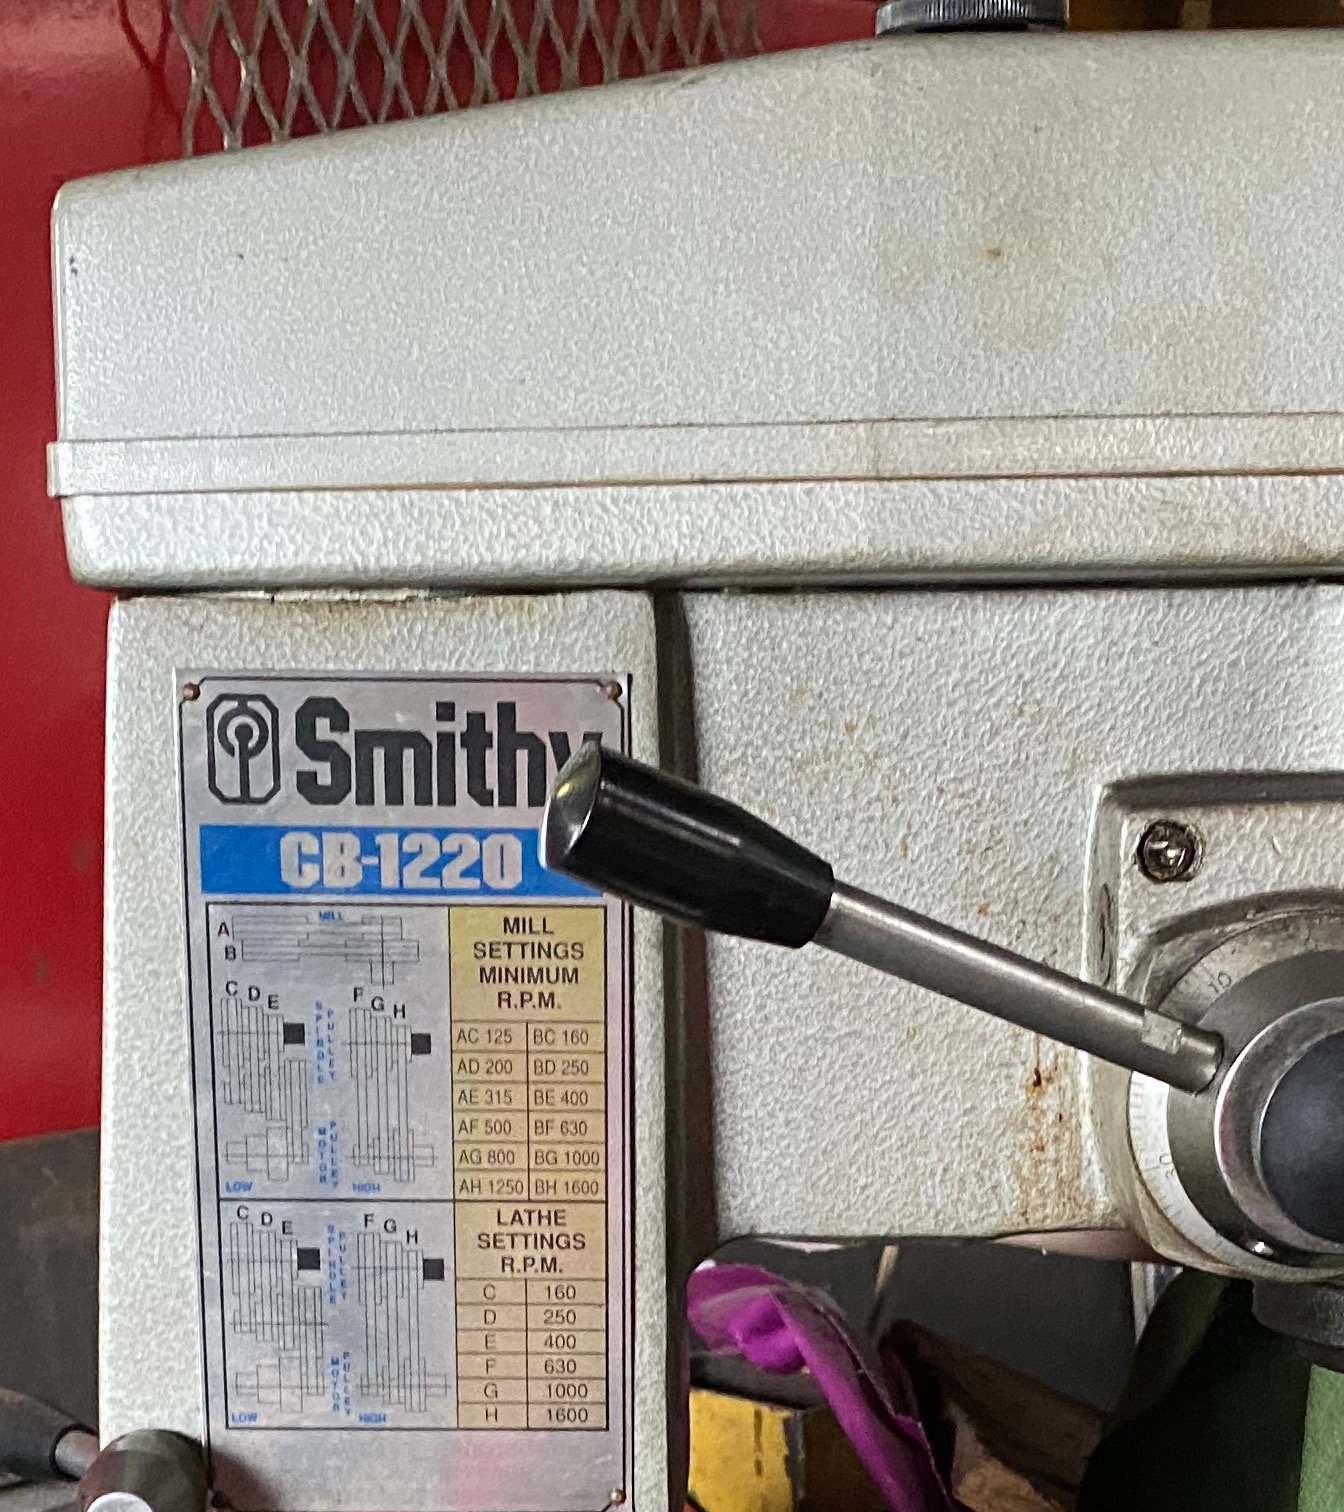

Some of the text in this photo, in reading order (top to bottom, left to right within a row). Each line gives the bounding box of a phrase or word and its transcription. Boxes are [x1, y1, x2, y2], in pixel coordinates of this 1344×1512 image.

[280, 831, 523, 890] CB-1220
[217, 922, 230, 937] A
[503, 916, 555, 935] MILL
[224, 944, 237, 961] B
[473, 941, 585, 960] SETTINGS
[479, 966, 579, 985] MINIMUM
[225, 980, 280, 1010] C D E
[353, 986, 406, 1019] F G H
[497, 990, 563, 1011] R.P.M.
[457, 1028, 513, 1045] AC 125
[533, 1028, 589, 1046] BC 160
[457, 1058, 513, 1075] AD 200
[533, 1059, 589, 1076] BD 250
[457, 1089, 513, 1106] AE 315
[534, 1089, 589, 1106] BE 400
[457, 1119, 512, 1136] AF 500
[534, 1120, 588, 1137] BF 630
[458, 1149, 515, 1166] AG 800
[534, 1150, 600, 1167] BG 1000
[225, 1181, 253, 1192] LOW
[459, 1179, 524, 1196] AH 1250
[535, 1180, 599, 1197] BH 1600
[236, 1205, 294, 1236] C D E
[496, 1209, 567, 1227] LATHE
[364, 1213, 419, 1245] F G H
[477, 1232, 587, 1251] SETTINGS
[501, 1256, 564, 1274] R.P.M.
[483, 1284, 496, 1300] C
[546, 1284, 577, 1300] 160
[483, 1309, 497, 1325] D
[543, 1309, 577, 1325] 250
[485, 1334, 497, 1350] E
[543, 1334, 577, 1350] 400
[485, 1358, 497, 1374] F
[544, 1358, 577, 1374] 630
[484, 1382, 498, 1399] G
[546, 1383, 588, 1399] 1000
[231, 1412, 258, 1423] LOW
[485, 1406, 498, 1423] H
[546, 1407, 589, 1423] 1600
